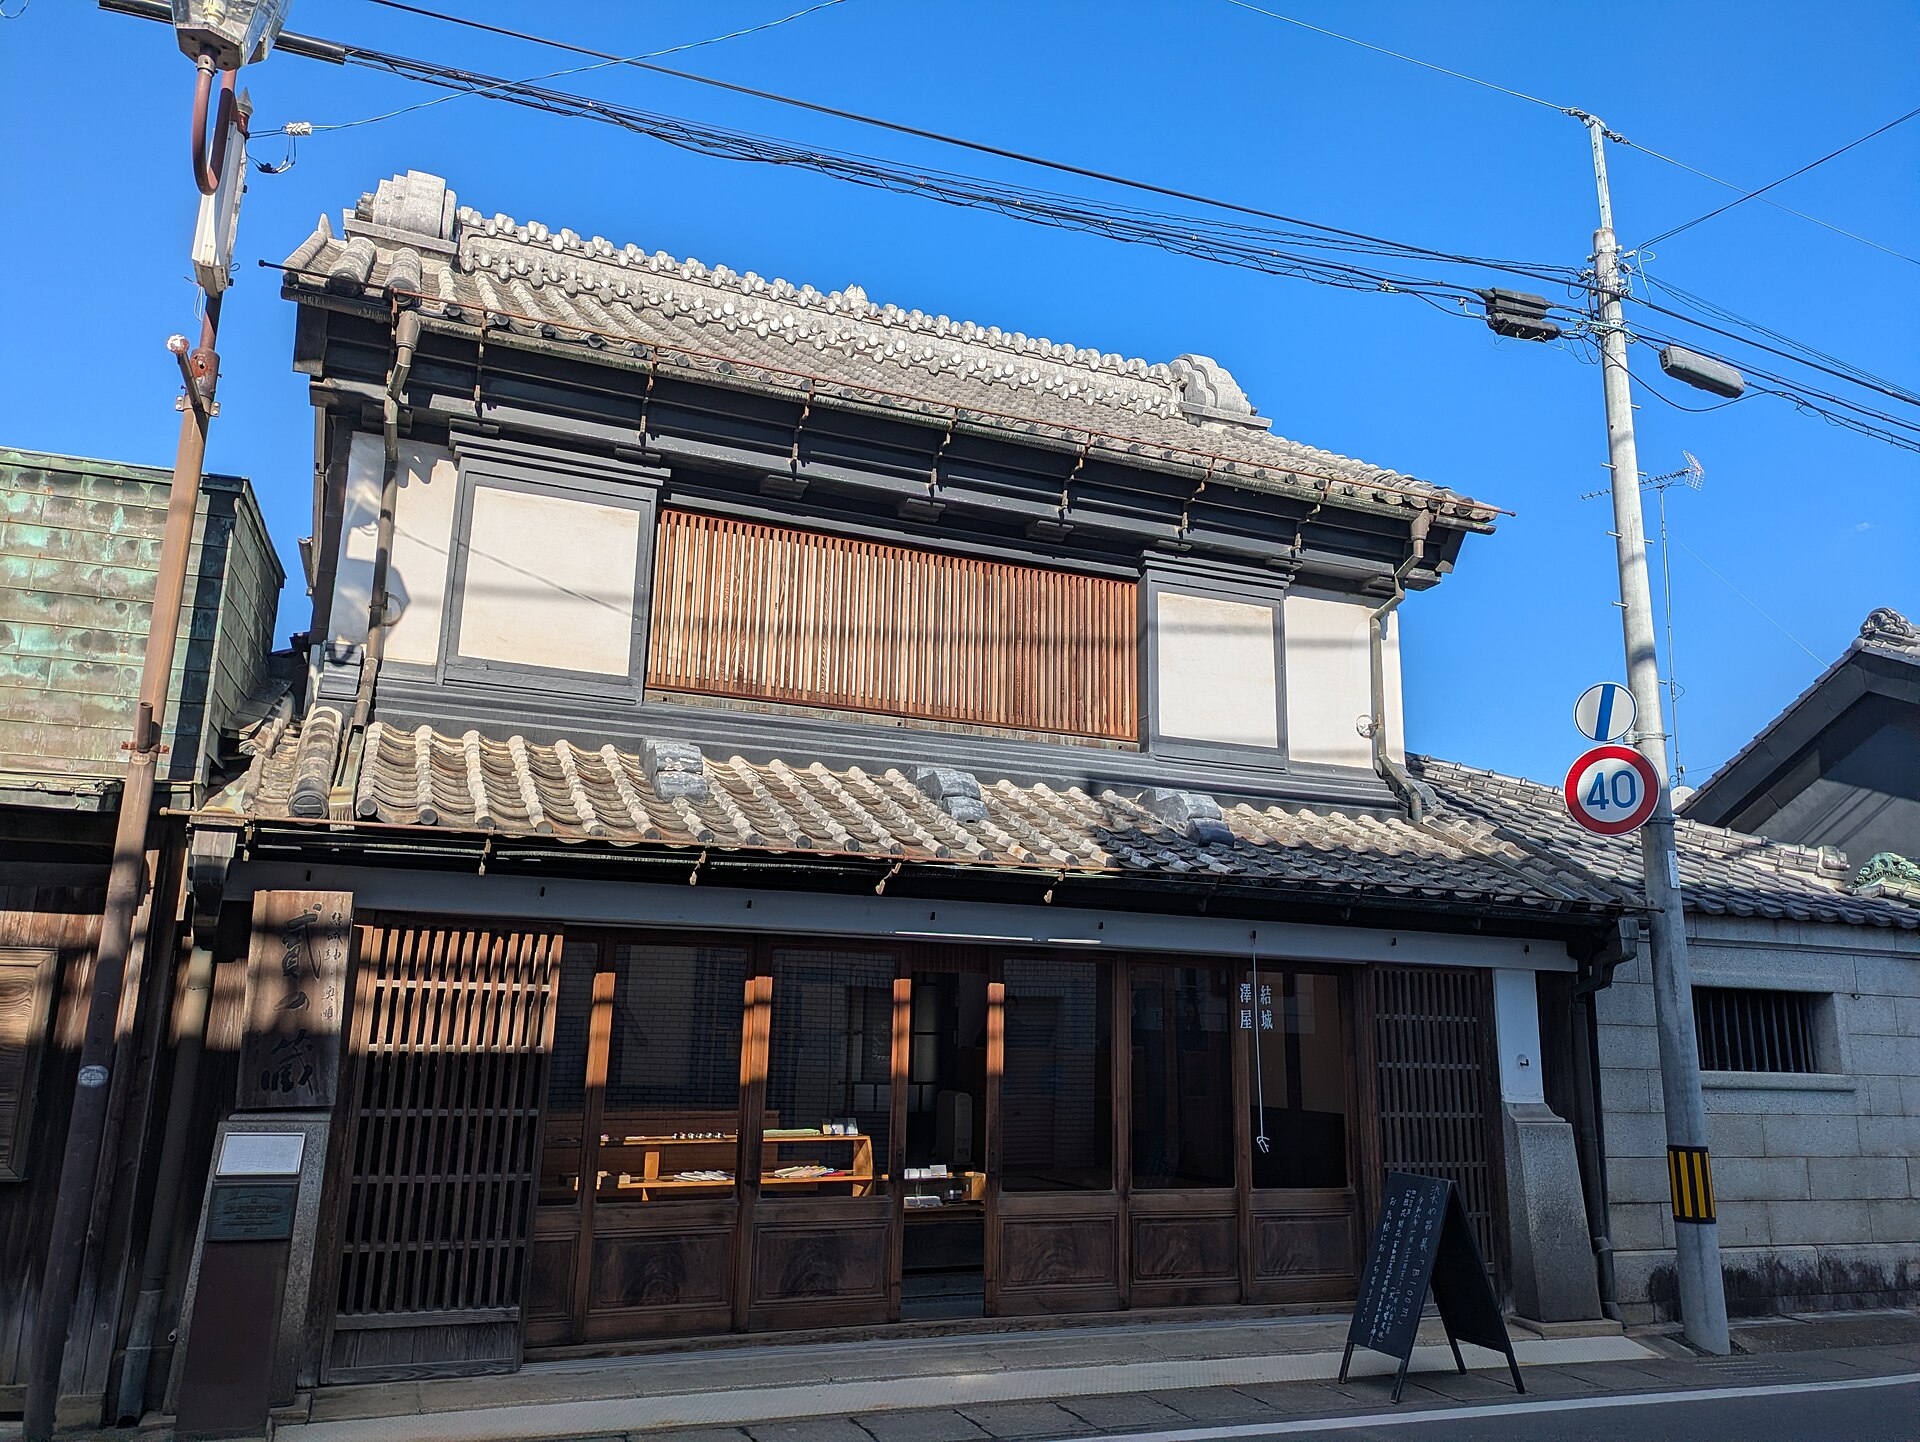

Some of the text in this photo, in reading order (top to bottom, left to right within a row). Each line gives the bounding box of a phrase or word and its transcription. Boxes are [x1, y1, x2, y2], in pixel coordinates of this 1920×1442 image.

[1586, 769, 1636, 810] 40
[1240, 983, 1252, 1029] 澤屋
[1260, 985, 1274, 1030] 結城
